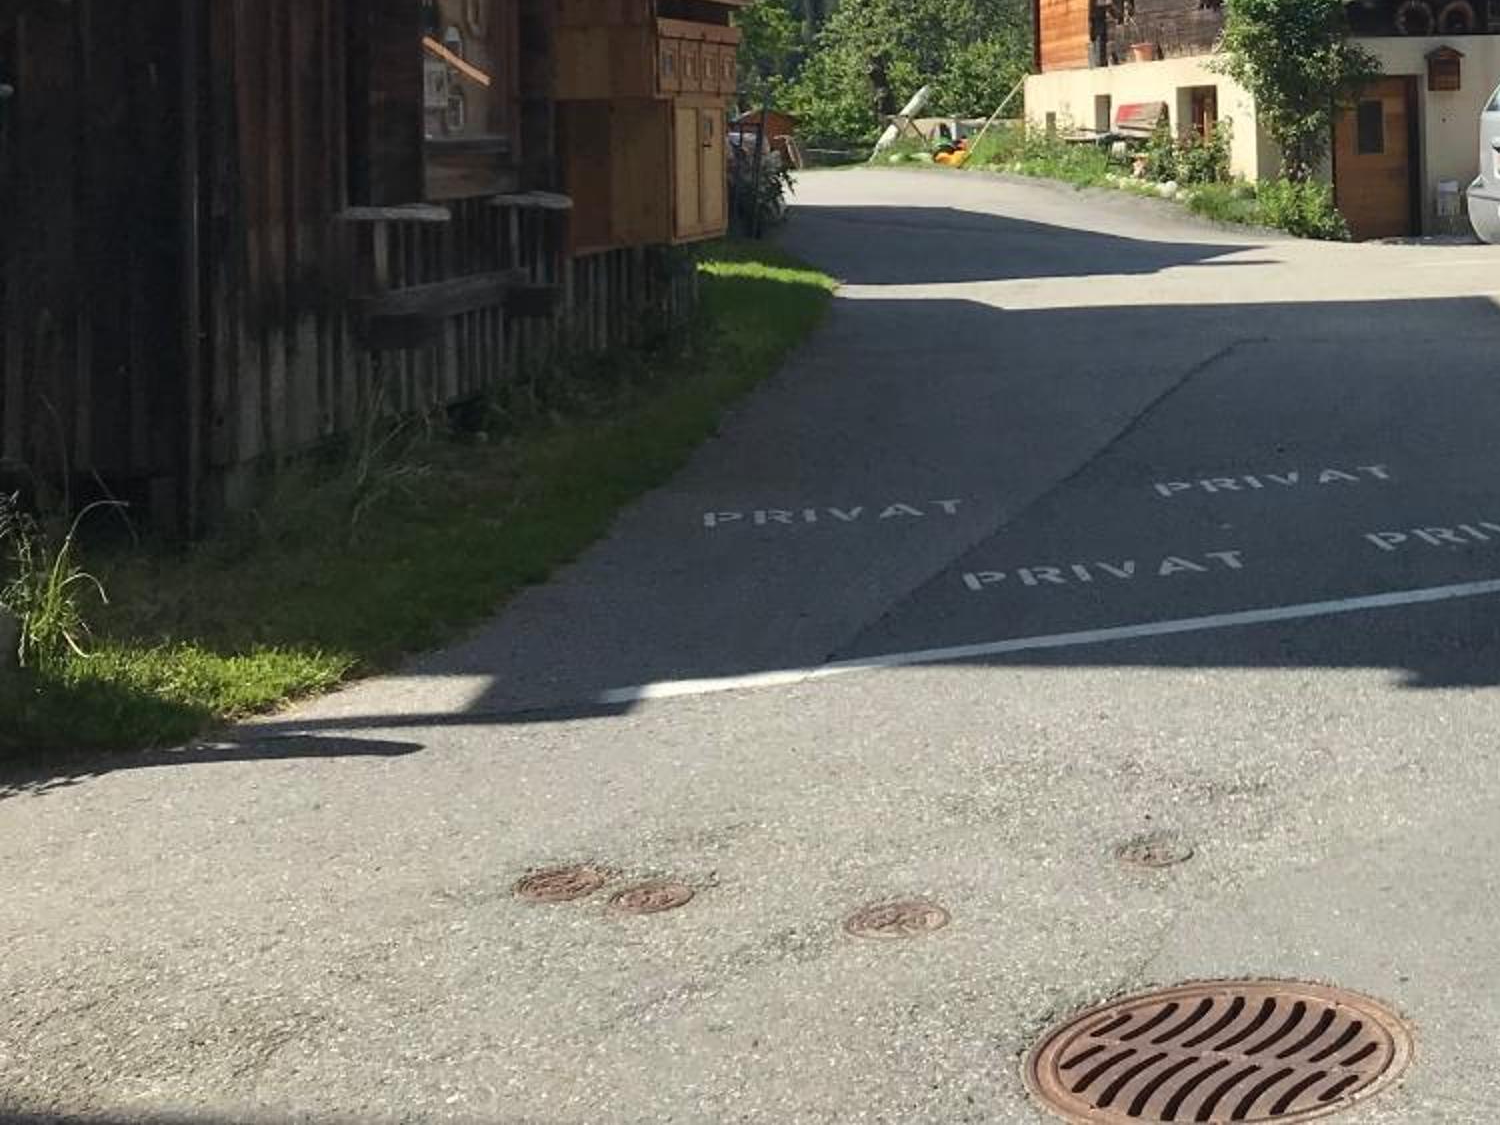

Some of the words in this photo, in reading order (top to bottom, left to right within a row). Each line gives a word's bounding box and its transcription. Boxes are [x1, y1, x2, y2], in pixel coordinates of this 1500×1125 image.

[1153, 463, 1391, 497] PRIVAT
[703, 498, 962, 527] PRIVAT
[962, 550, 1246, 591] PRIVAT
